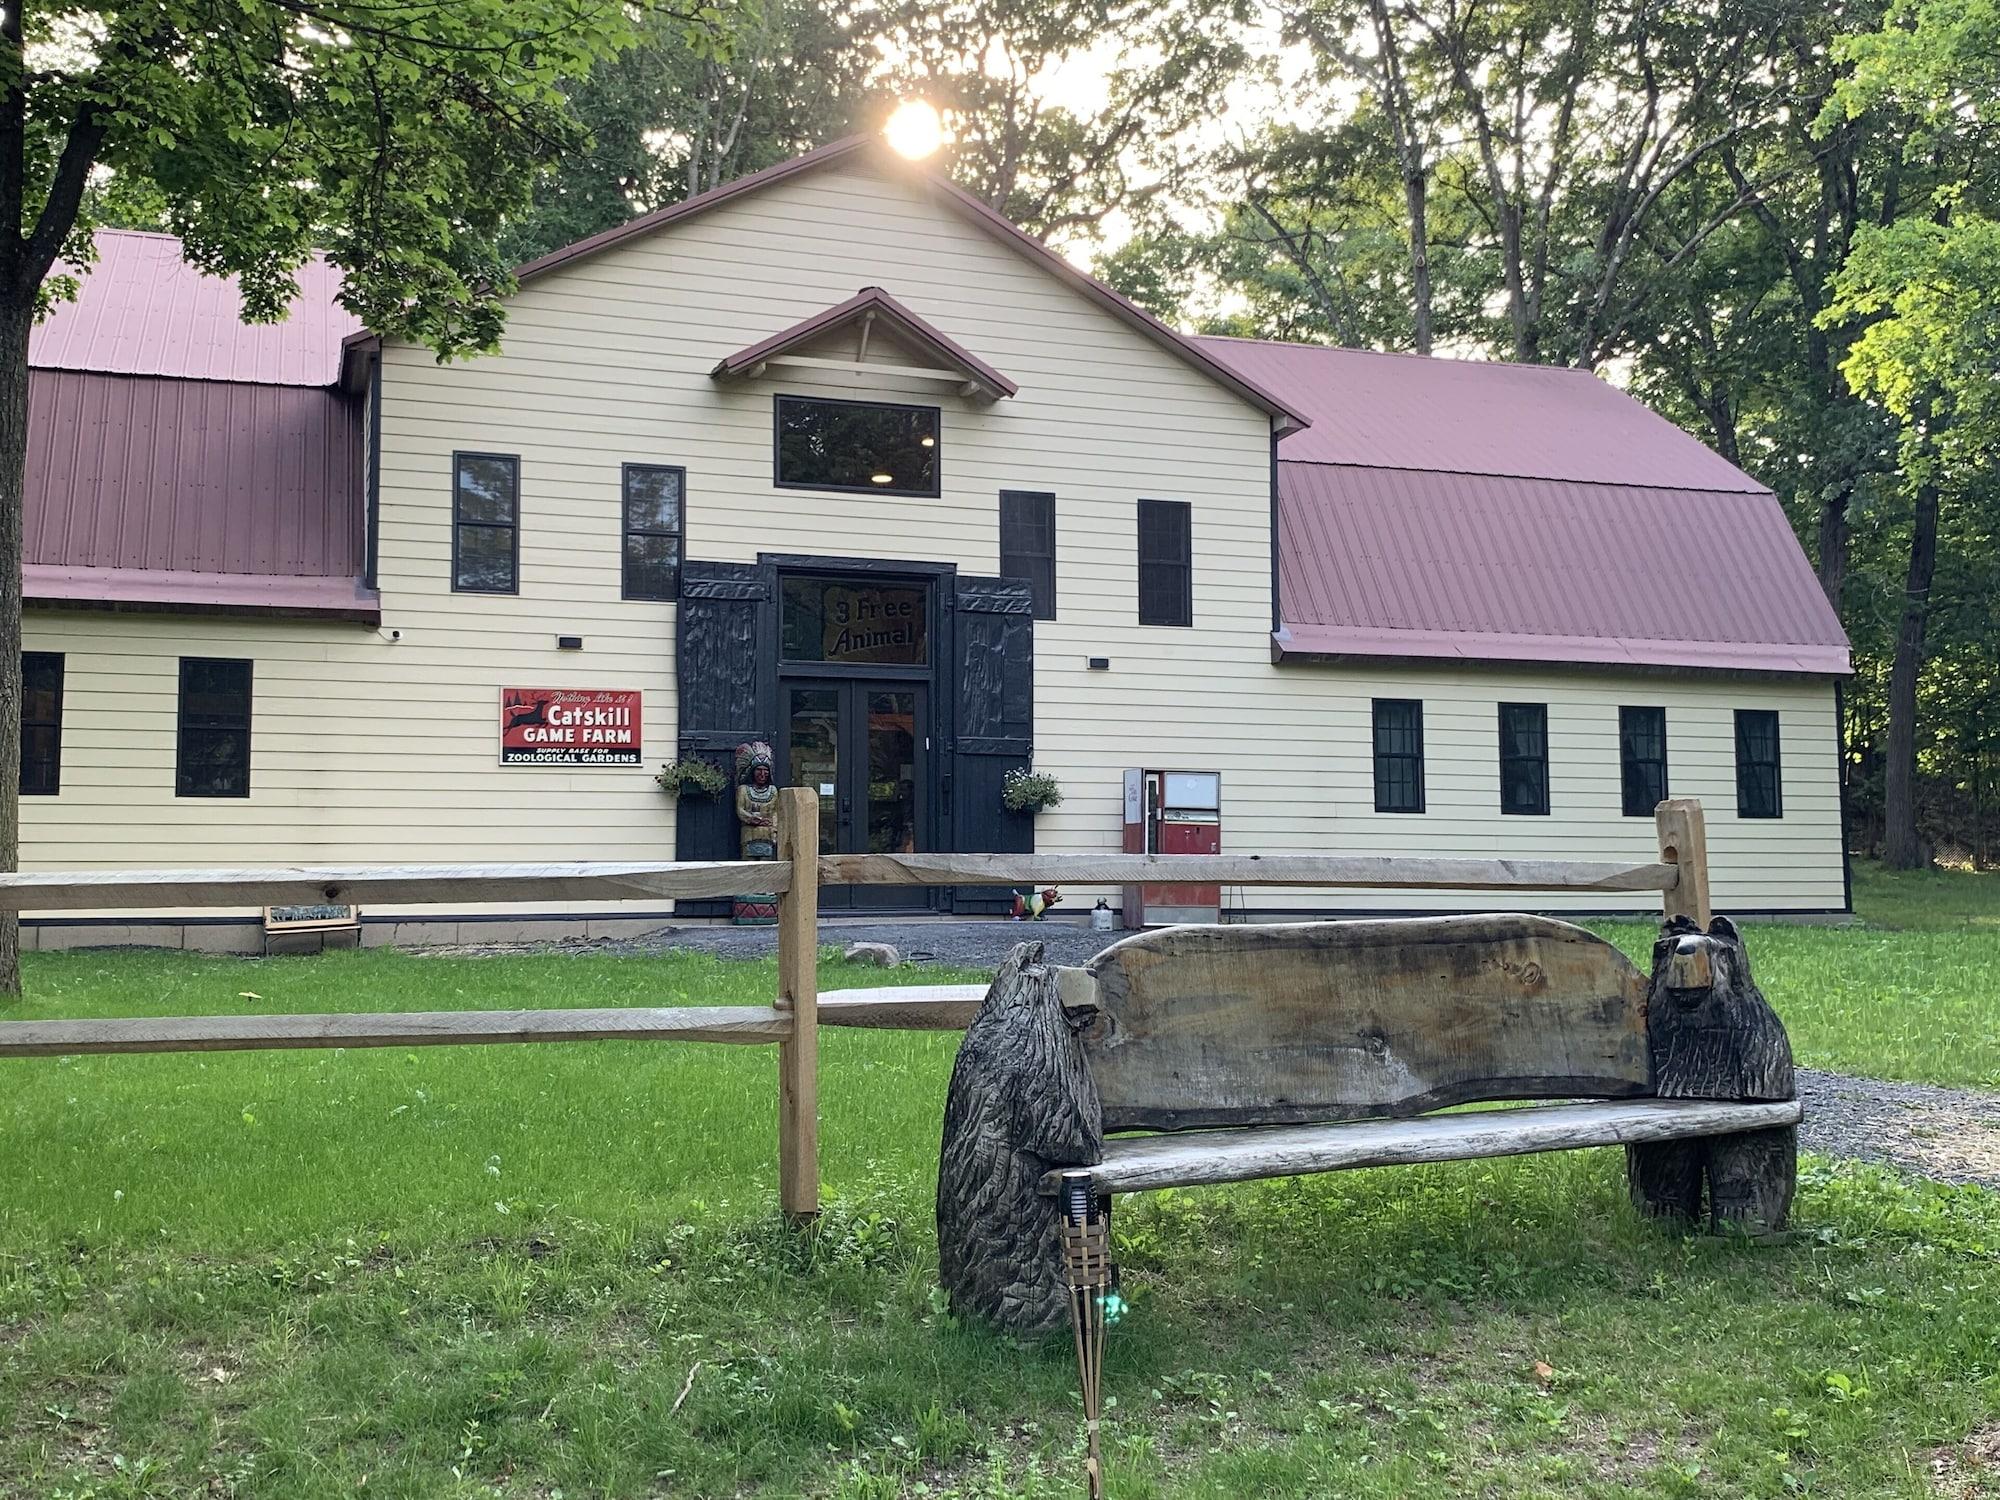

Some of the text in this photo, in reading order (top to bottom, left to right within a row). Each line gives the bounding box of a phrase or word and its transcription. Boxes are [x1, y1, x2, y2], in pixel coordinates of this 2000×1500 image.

[833, 598, 912, 625] 3 Free
[827, 622, 913, 657] Animal
[551, 691, 591, 707] Nothing
[548, 705, 630, 726] Catskill
[523, 728, 632, 743] GAME FARM
[507, 753, 637, 763] ZOOLOGICAL GARDENS
